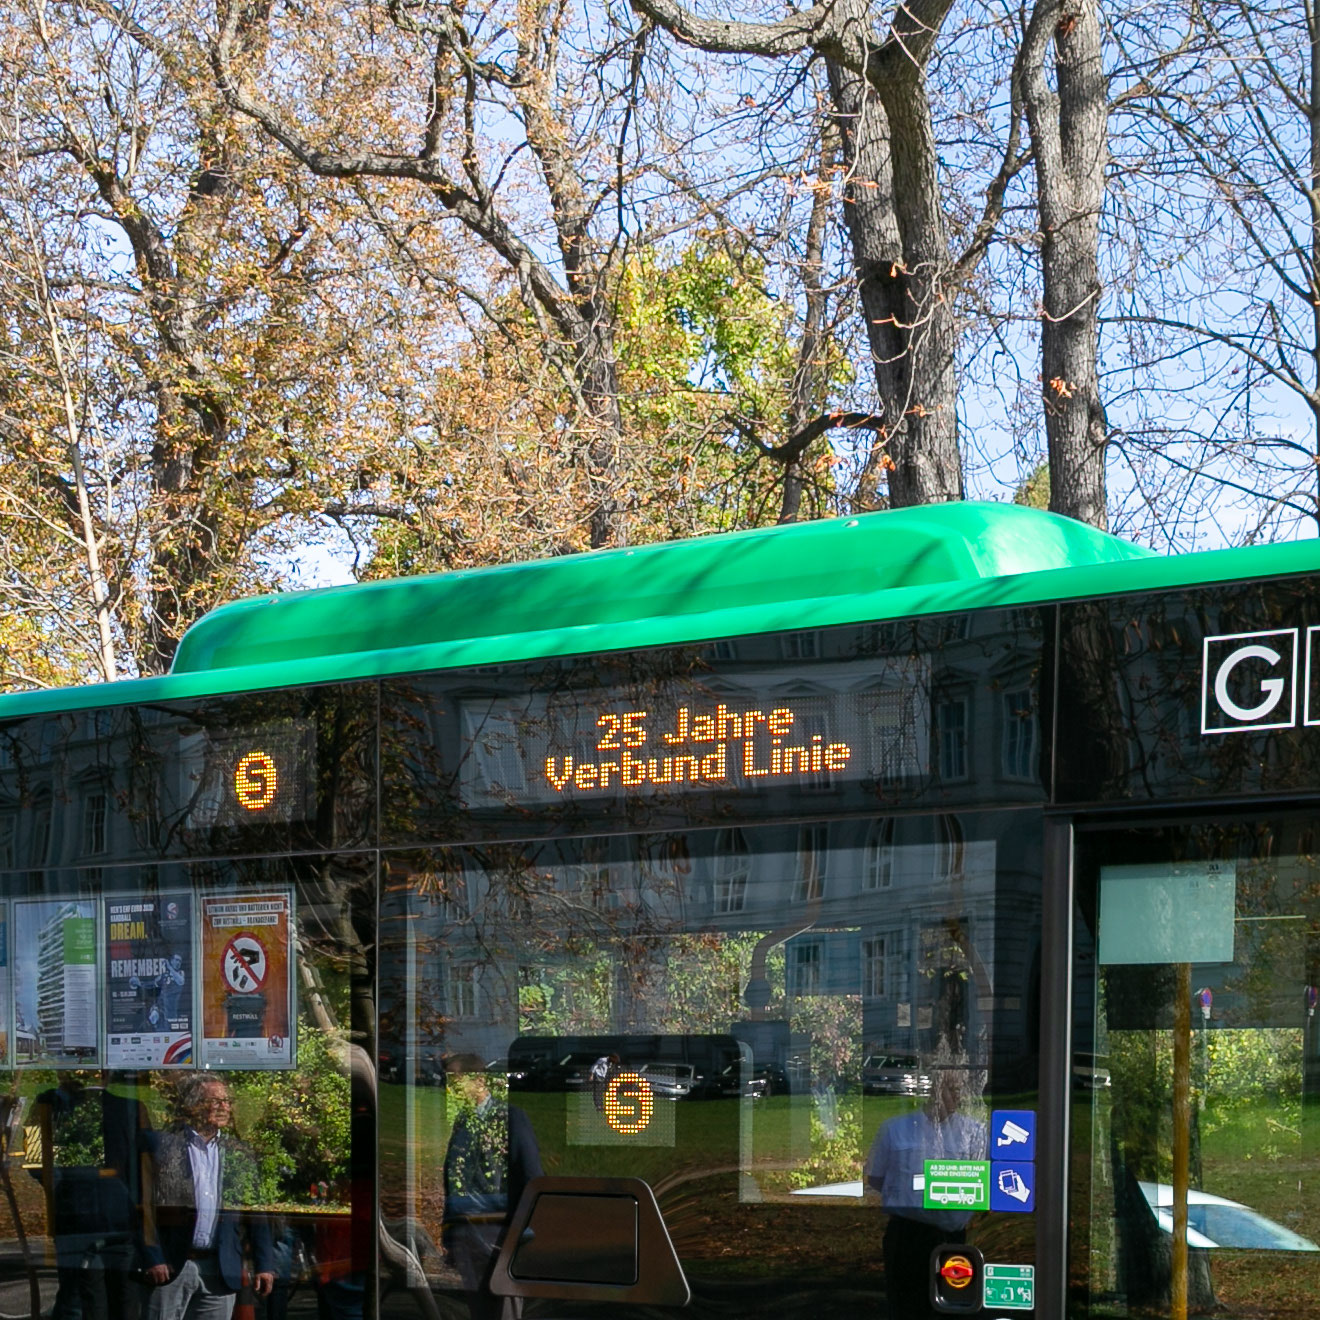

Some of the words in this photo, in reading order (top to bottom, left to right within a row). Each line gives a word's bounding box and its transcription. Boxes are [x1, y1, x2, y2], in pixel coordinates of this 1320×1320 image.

[596, 711, 648, 751] 25
[664, 703, 794, 744] Jahre
[545, 743, 727, 791] Verbund
[743, 734, 852, 777] Linie
